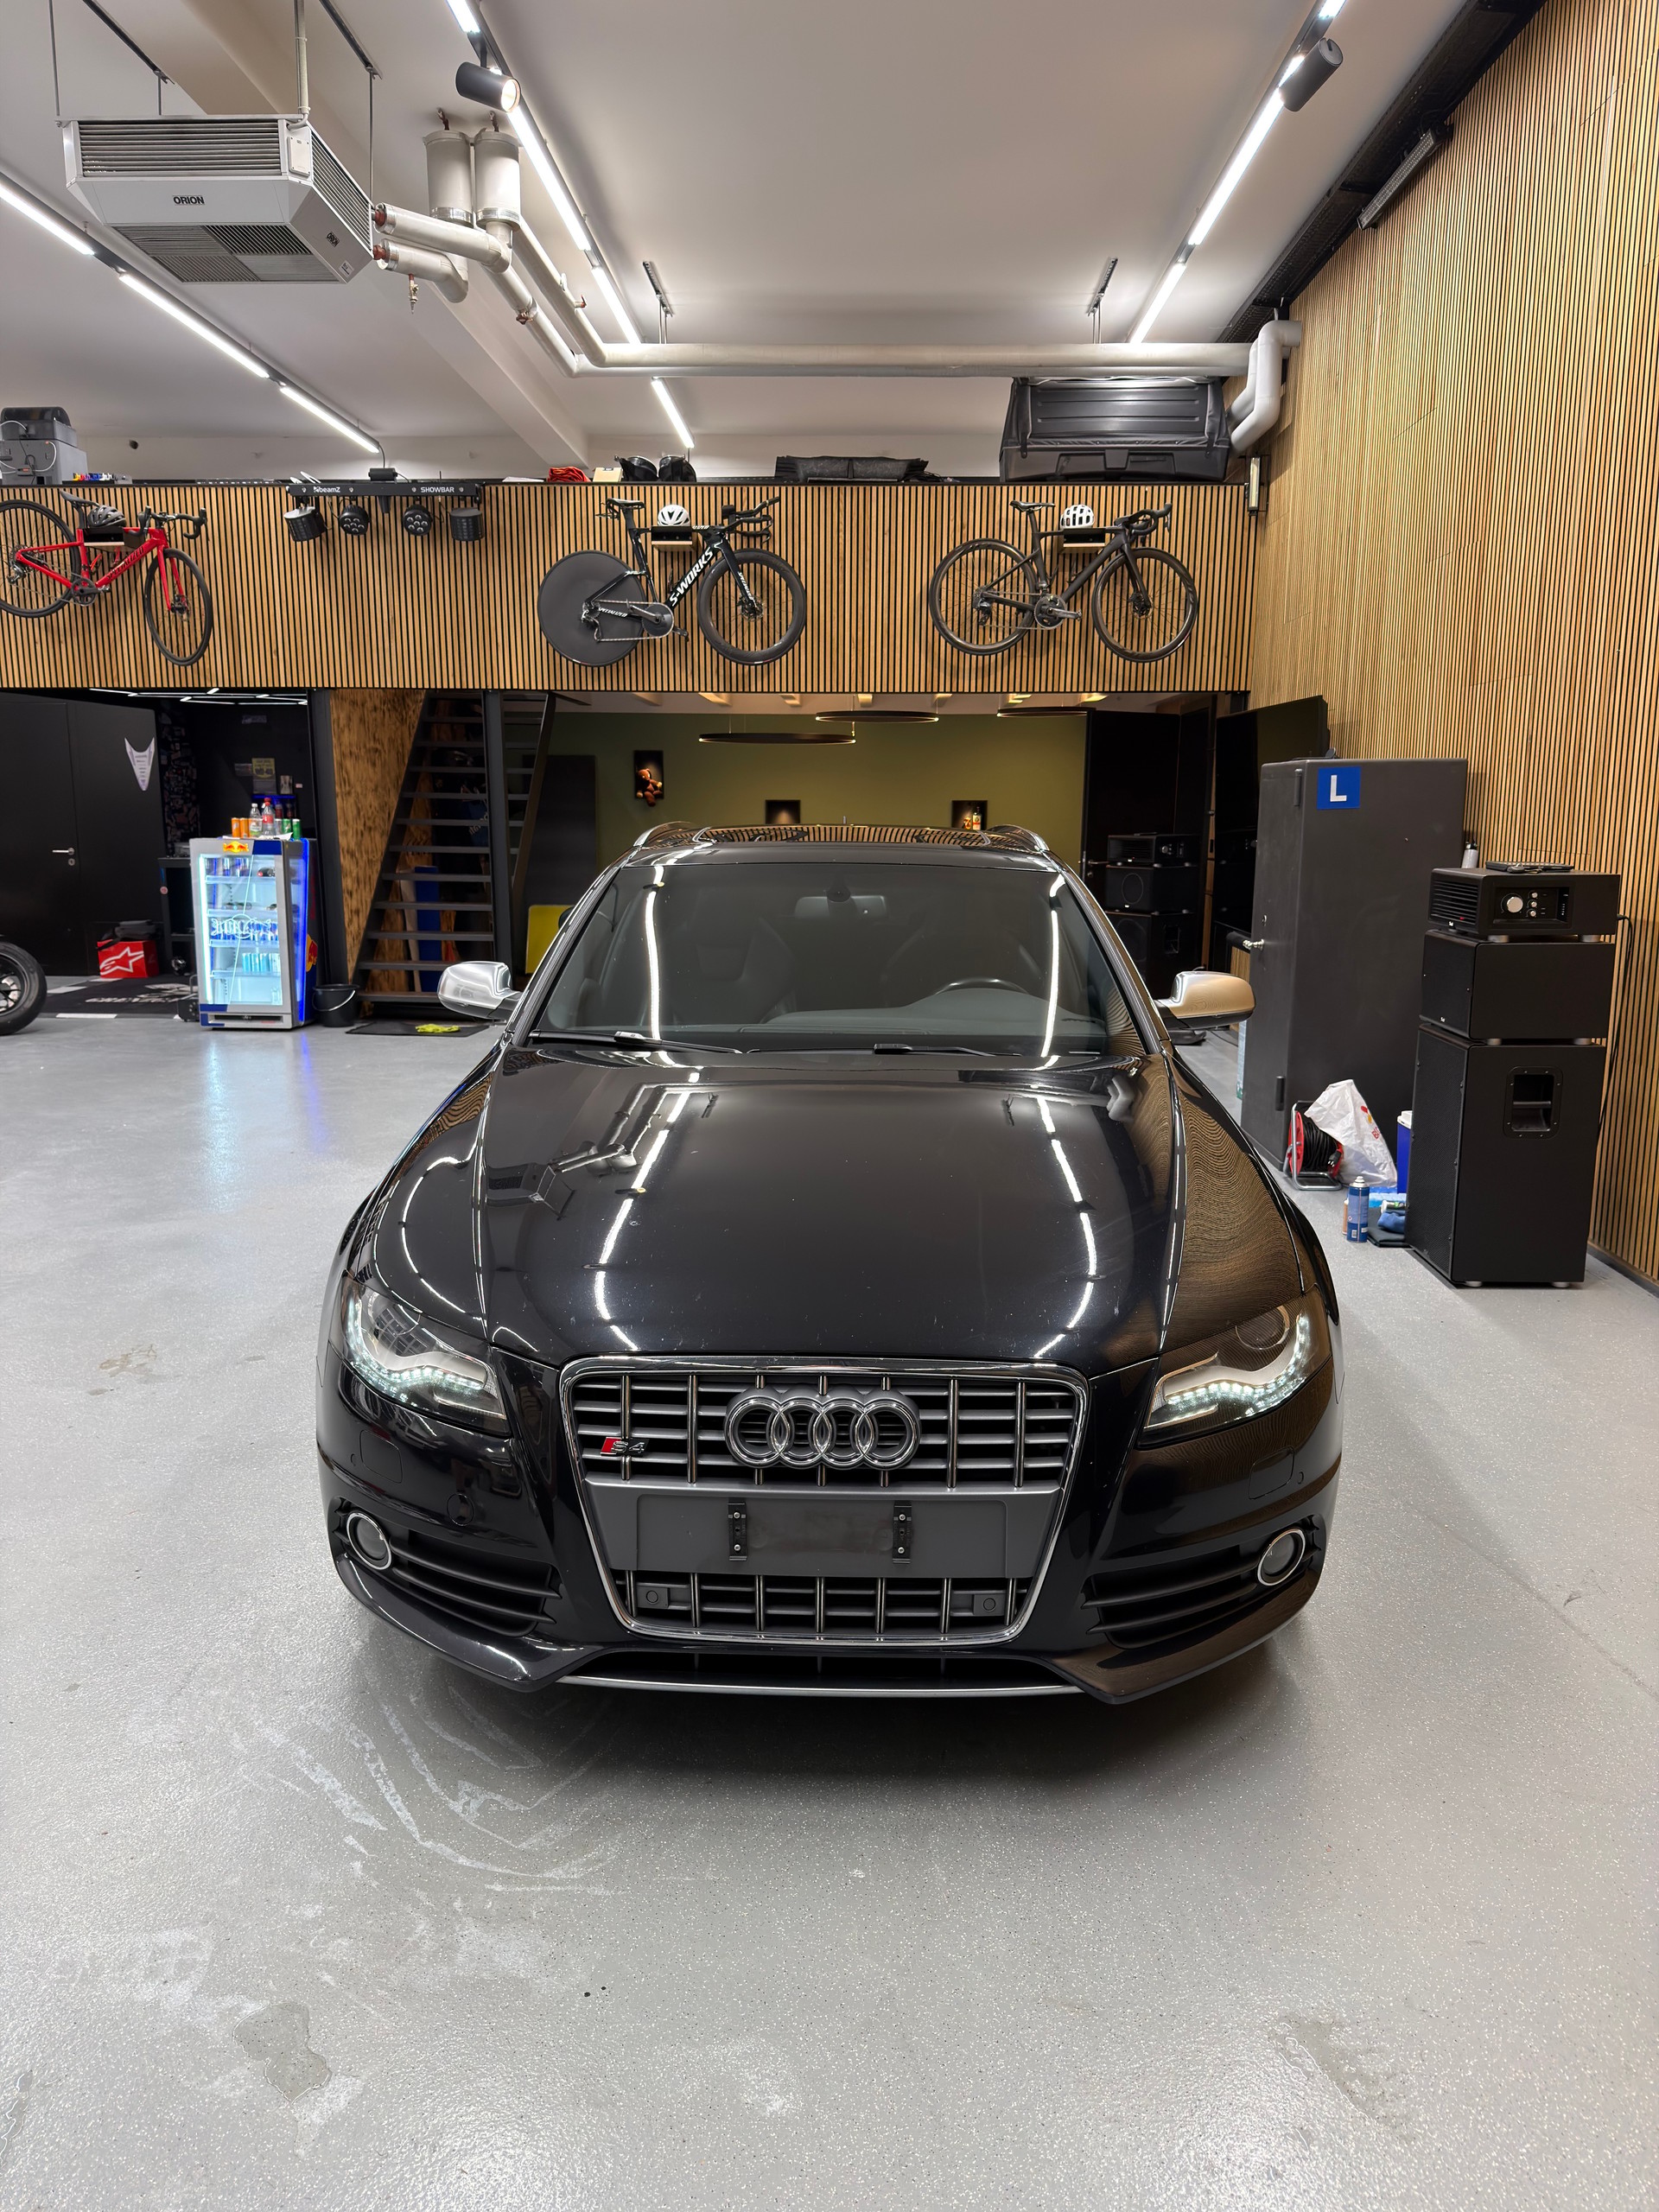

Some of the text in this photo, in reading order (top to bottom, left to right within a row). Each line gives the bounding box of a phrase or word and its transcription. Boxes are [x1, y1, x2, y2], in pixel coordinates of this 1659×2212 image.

[173, 196, 205, 205] ORION
[670, 547, 714, 607] S-WORKS
[1330, 774, 1347, 802] L
[610, 1440, 645, 1453] S4
